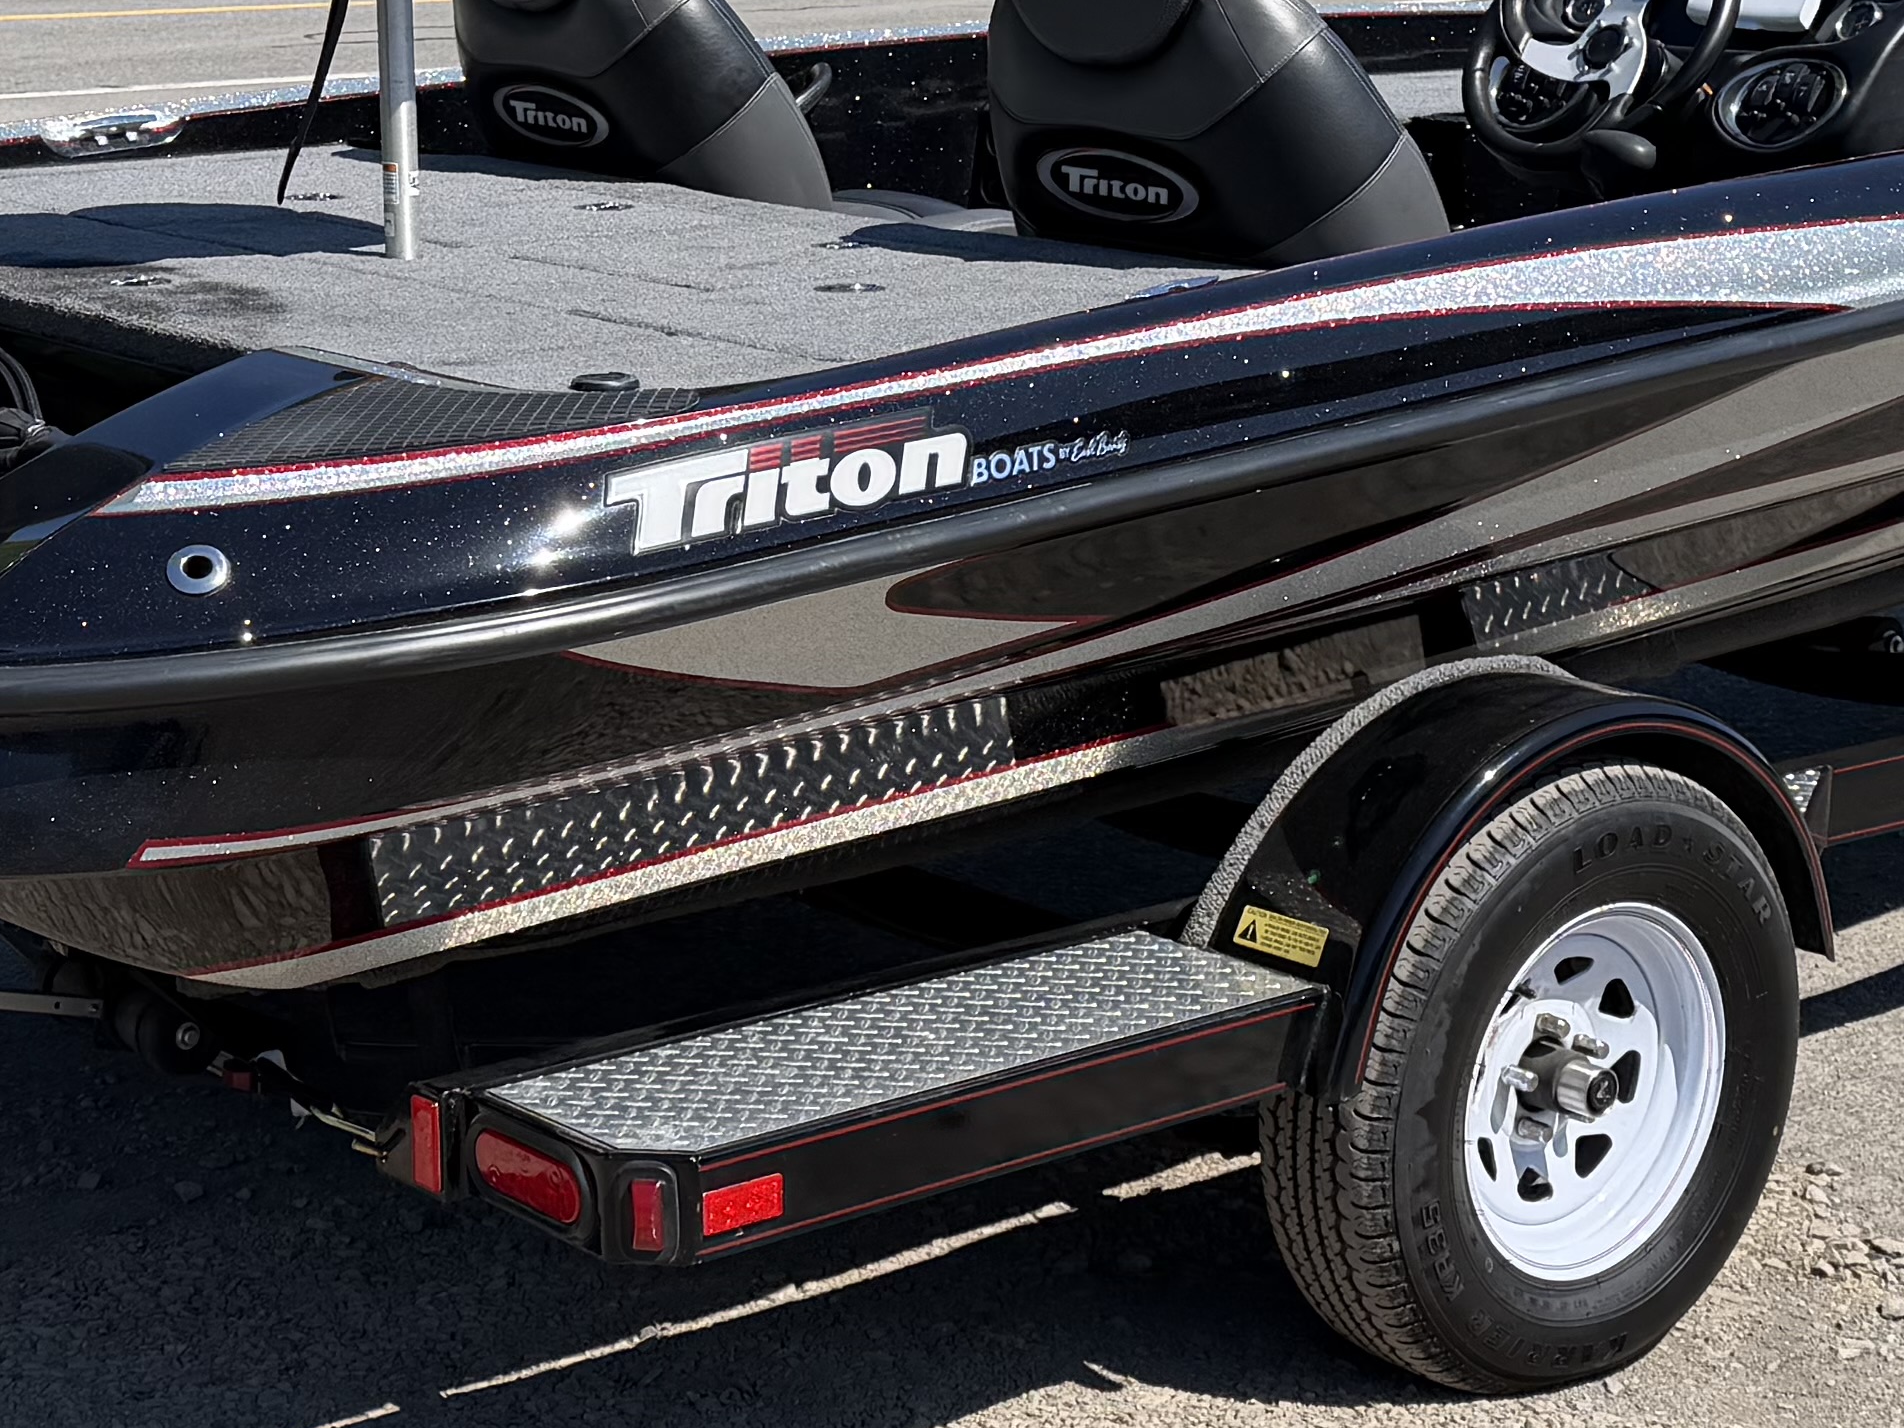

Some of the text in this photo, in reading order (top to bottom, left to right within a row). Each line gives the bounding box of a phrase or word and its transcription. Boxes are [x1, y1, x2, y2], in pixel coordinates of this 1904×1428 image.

[509, 99, 588, 133] Triton
[1061, 165, 1169, 205] Triton
[606, 432, 969, 555] Triton
[971, 443, 1056, 487] BOATS
[1573, 824, 1773, 926] LOAD STAR
